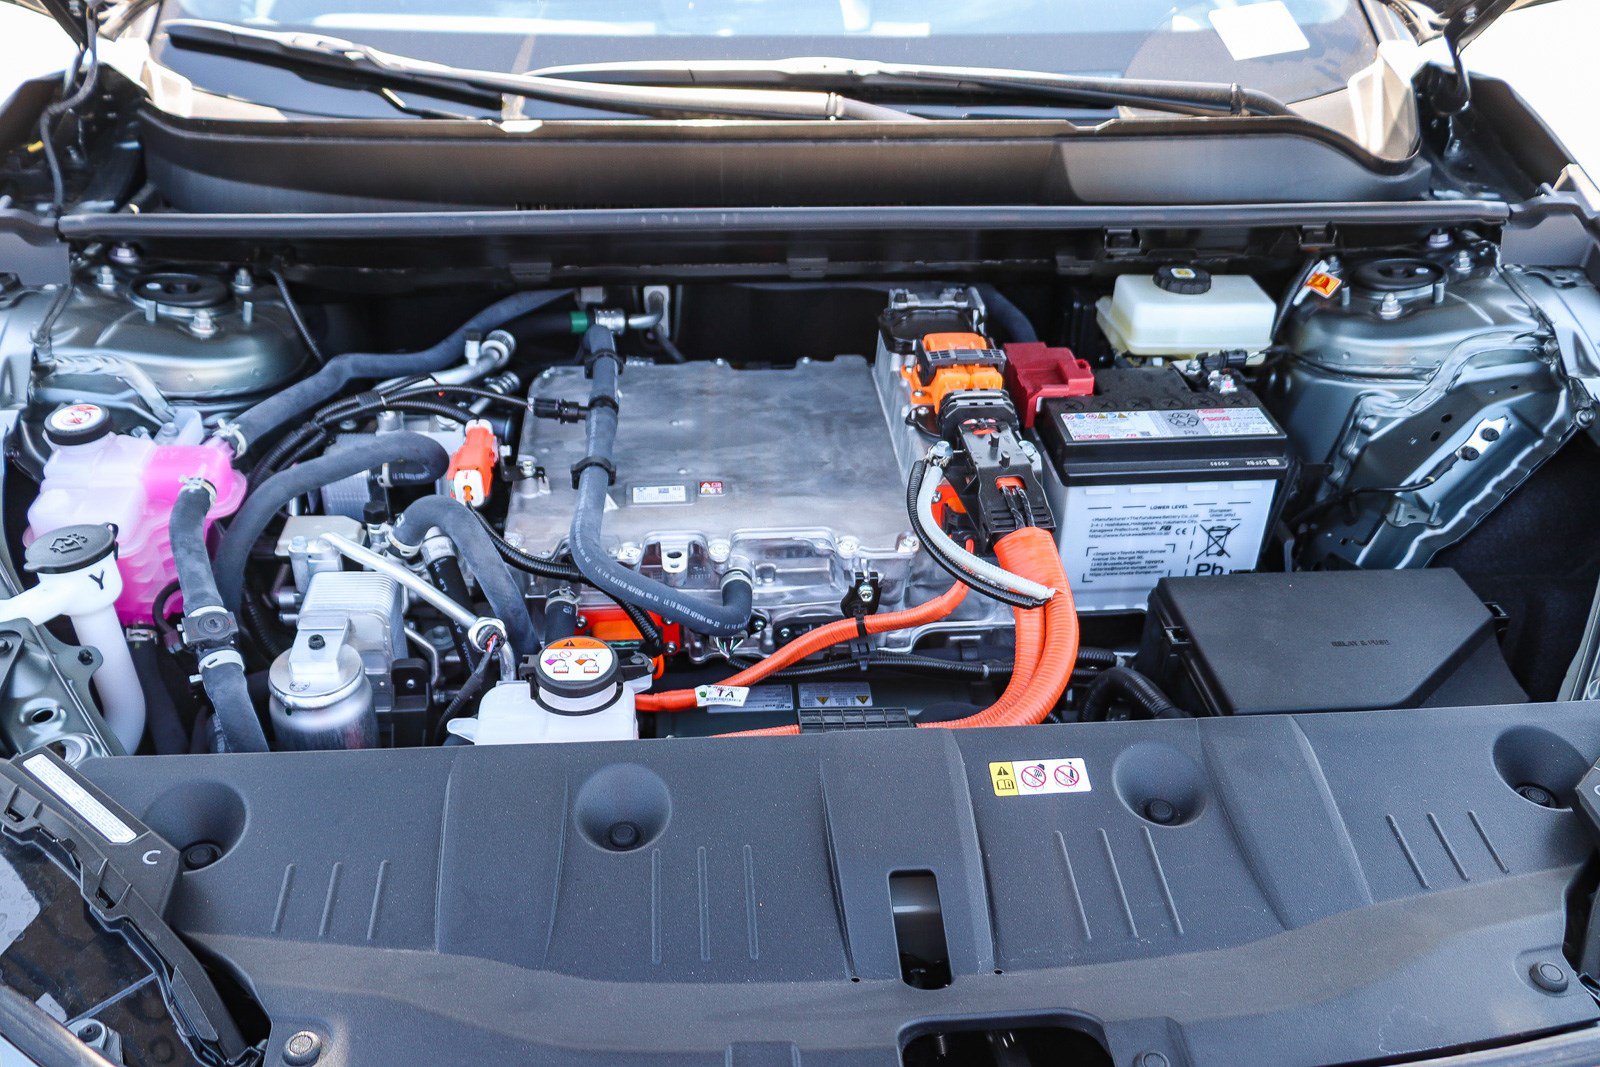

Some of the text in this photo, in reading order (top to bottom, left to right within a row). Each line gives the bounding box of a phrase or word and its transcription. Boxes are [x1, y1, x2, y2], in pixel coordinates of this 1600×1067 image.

[1195, 562, 1224, 576] Pb
[88, 569, 105, 590] Y
[142, 849, 161, 865] C
